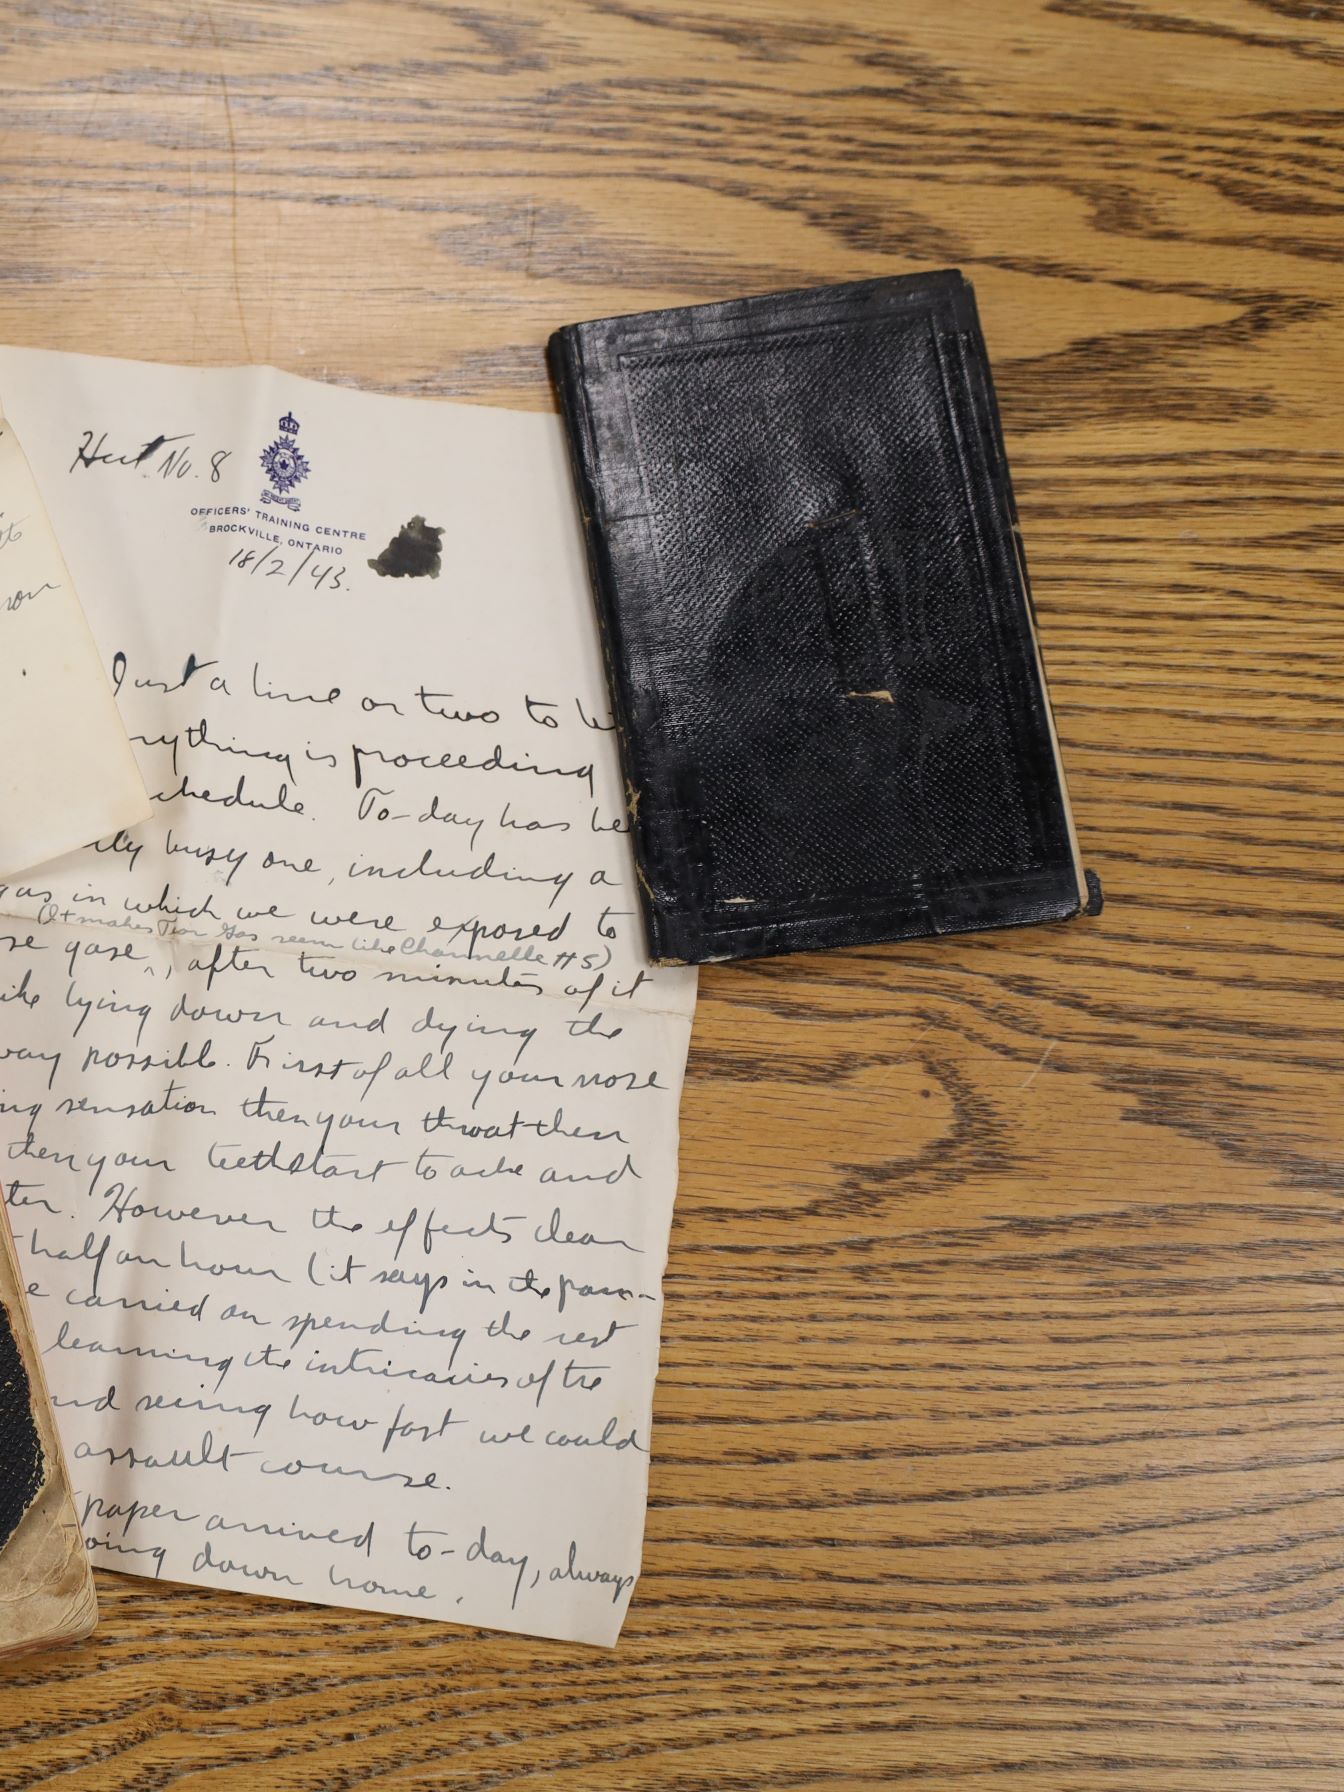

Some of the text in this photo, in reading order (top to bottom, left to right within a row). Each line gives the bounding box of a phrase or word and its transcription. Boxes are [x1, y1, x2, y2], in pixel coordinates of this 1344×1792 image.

[69, 430, 196, 474] Hut
[210, 450, 233, 483] 8
[190, 505, 367, 541] OFFICERS' TRAINING CENTRE
[208, 523, 344, 556] BROCKVILLE, ONTARIO
[0, 582, 61, 615] son
[209, 676, 232, 696] a
[253, 661, 342, 704] line
[361, 697, 405, 716] or
[414, 685, 501, 724] two
[525, 694, 559, 729] to
[306, 740, 594, 798] is proceeding
[357, 787, 571, 852] To-day has
[166, 829, 248, 886] busy
[348, 848, 574, 909] including
[590, 869, 624, 886] a
[73, 883, 106, 906] in
[124, 883, 221, 920] which
[237, 904, 296, 919] we
[311, 910, 406, 932] were
[427, 911, 572, 960] exposed
[597, 906, 637, 940] to
[271, 934, 344, 949] seem
[352, 938, 395, 954] like
[188, 943, 654, 1014] after two minutes of it
[66, 981, 152, 1047] lying
[170, 992, 292, 1026] down
[308, 1006, 390, 1035] and
[411, 1005, 538, 1066] dying
[565, 1011, 624, 1040] the
[246, 1034, 364, 1080] First
[353, 1051, 393, 1102] of
[394, 1051, 454, 1081] all
[472, 1068, 564, 1110] your
[571, 1070, 670, 1091] nose
[56, 1079, 216, 1119] sensation
[240, 1086, 310, 1126] then
[316, 1111, 401, 1155] your
[421, 1105, 522, 1140] throat
[524, 1107, 630, 1144] then
[7, 1131, 642, 1196] then your teeth start to ache and
[98, 1182, 645, 1261] However the effects clear
[31, 1228, 551, 1314] half an hour says in the
[65, 1287, 639, 1370] carried on spending the rest
[41, 1321, 612, 1408] learning the intricacies of the
[73, 1430, 264, 1472] assault
[289, 1393, 651, 1453] how fast we could
[81, 1493, 634, 1604] paper arrived always
[192, 1541, 304, 1585] down
